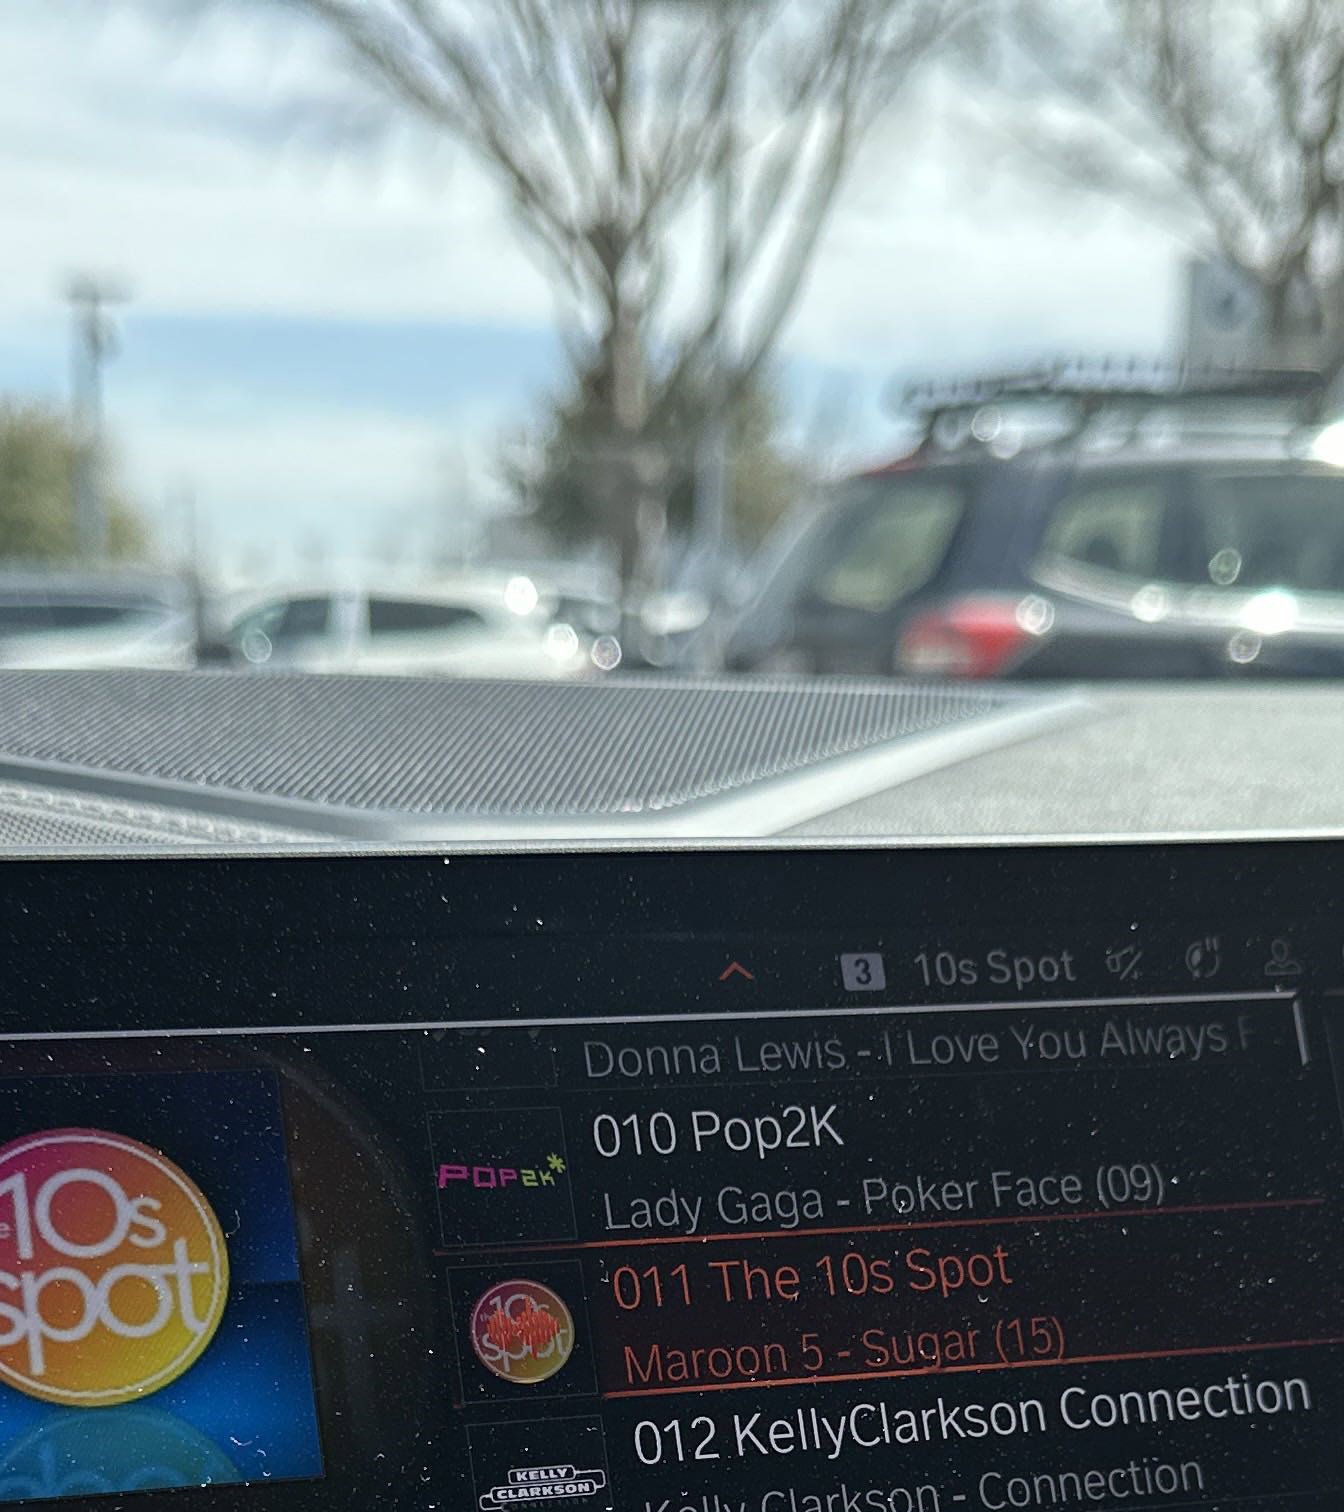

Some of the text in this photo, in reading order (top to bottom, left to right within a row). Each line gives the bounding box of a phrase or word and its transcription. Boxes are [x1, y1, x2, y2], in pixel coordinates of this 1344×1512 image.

[914, 951, 1076, 991] 10s Spot
[584, 1037, 722, 1078] Donna
[736, 1034, 846, 1074] Lewis
[909, 1028, 999, 1065] Love
[1009, 1024, 1087, 1060] You
[1101, 1019, 1228, 1061] Always
[593, 1105, 844, 1159] 010 Pop2K
[604, 1190, 700, 1236] Lady
[718, 1185, 824, 1232] Gaga
[863, 1173, 978, 1215] Poker
[992, 1169, 1083, 1207] Face
[1097, 1162, 1164, 1207] (09)
[613, 1244, 1013, 1309] 011 The 10s Spot
[624, 1341, 790, 1384] Maroon
[803, 1331, 825, 1372] 5
[862, 1322, 979, 1371] Sugar
[996, 1315, 1067, 1364] (15)
[633, 1374, 1311, 1466] 012 KellyClarkson Connection
[497, 1483, 590, 1499] CLARKSON
[516, 1468, 567, 1481] KELLY
[979, 1454, 1205, 1510] Connection
